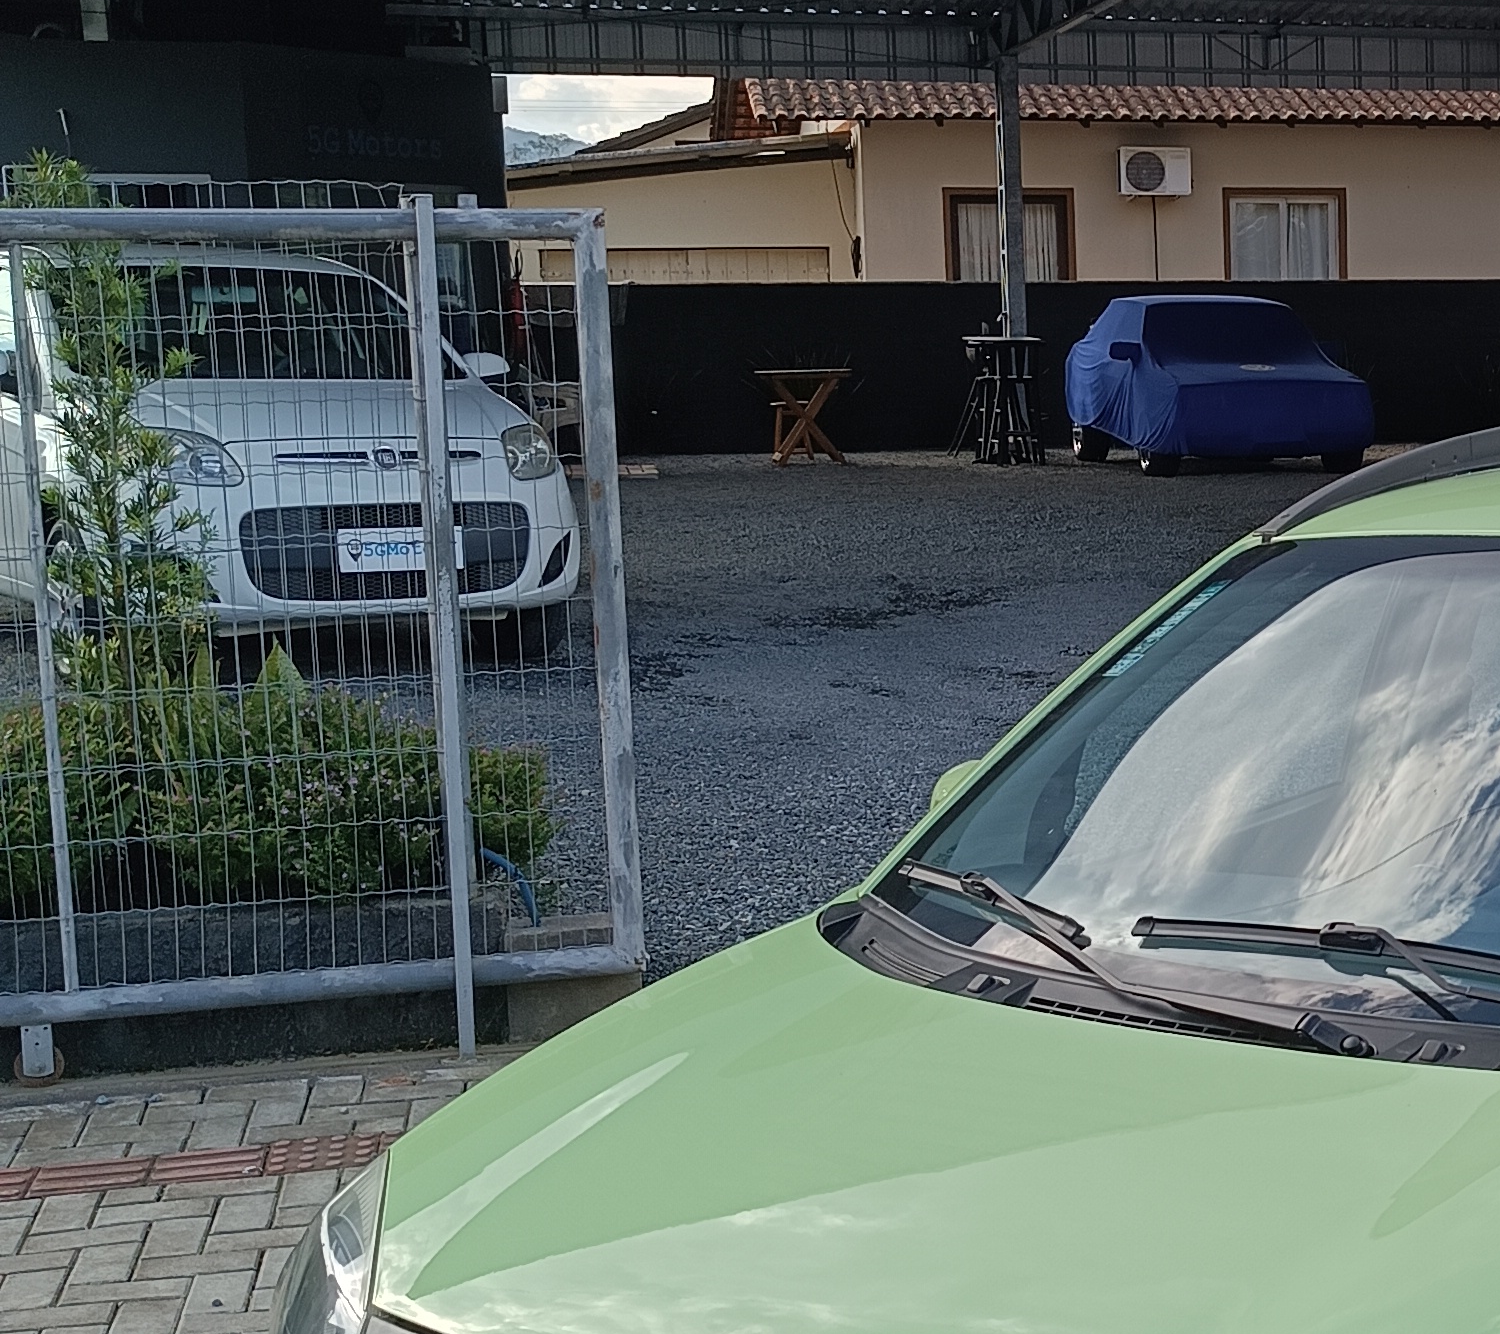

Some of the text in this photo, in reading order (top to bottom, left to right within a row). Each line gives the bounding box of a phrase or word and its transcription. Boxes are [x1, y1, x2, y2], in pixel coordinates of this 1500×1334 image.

[307, 124, 442, 160] 5G Motors
[363, 541, 424, 557] 5GMot
